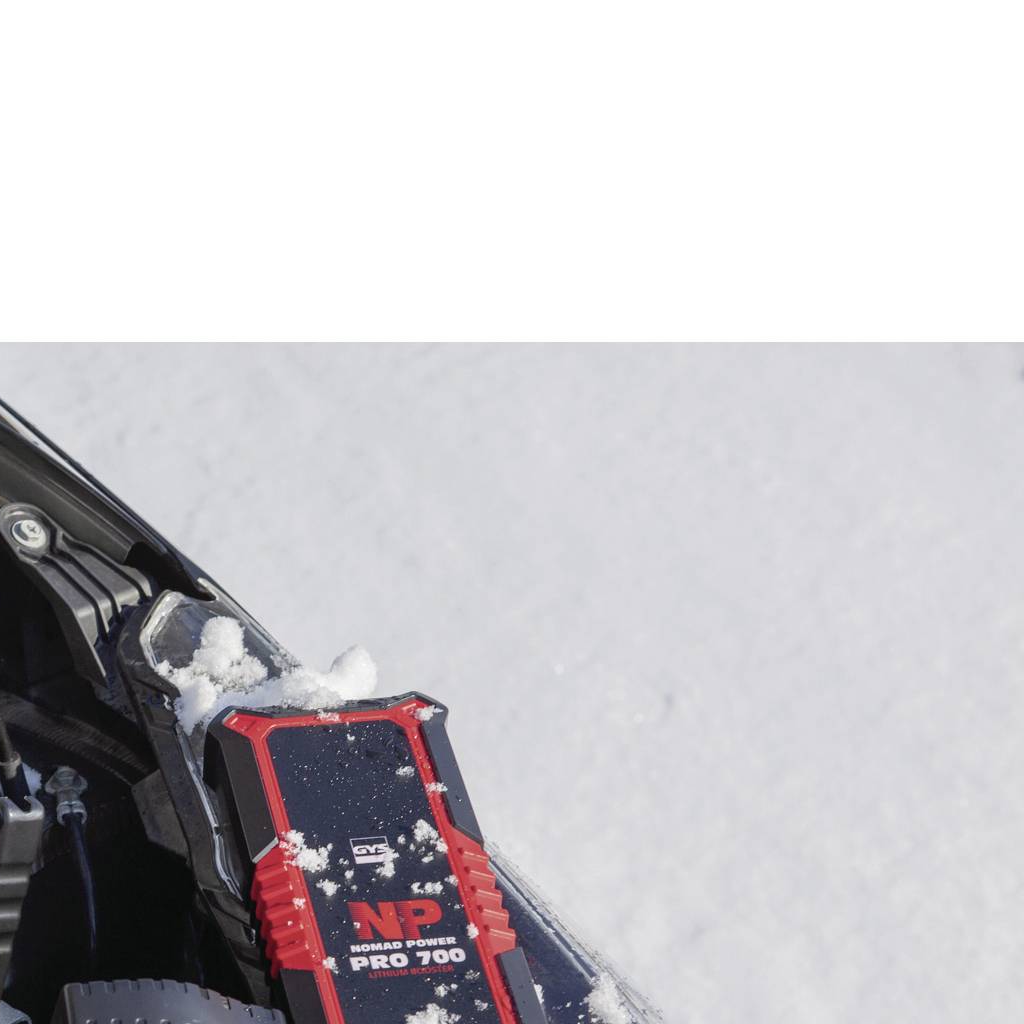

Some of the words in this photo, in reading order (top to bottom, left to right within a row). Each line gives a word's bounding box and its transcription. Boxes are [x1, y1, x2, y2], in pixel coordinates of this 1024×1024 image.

[352, 843, 390, 855] GYS
[348, 899, 443, 940] NP
[351, 940, 403, 953] NOMAD
[406, 936, 457, 949] POWER
[349, 953, 409, 972] PRO
[416, 947, 466, 966] 700
[368, 968, 409, 979] LITHIUM
[410, 964, 454, 976] BOOSTER
